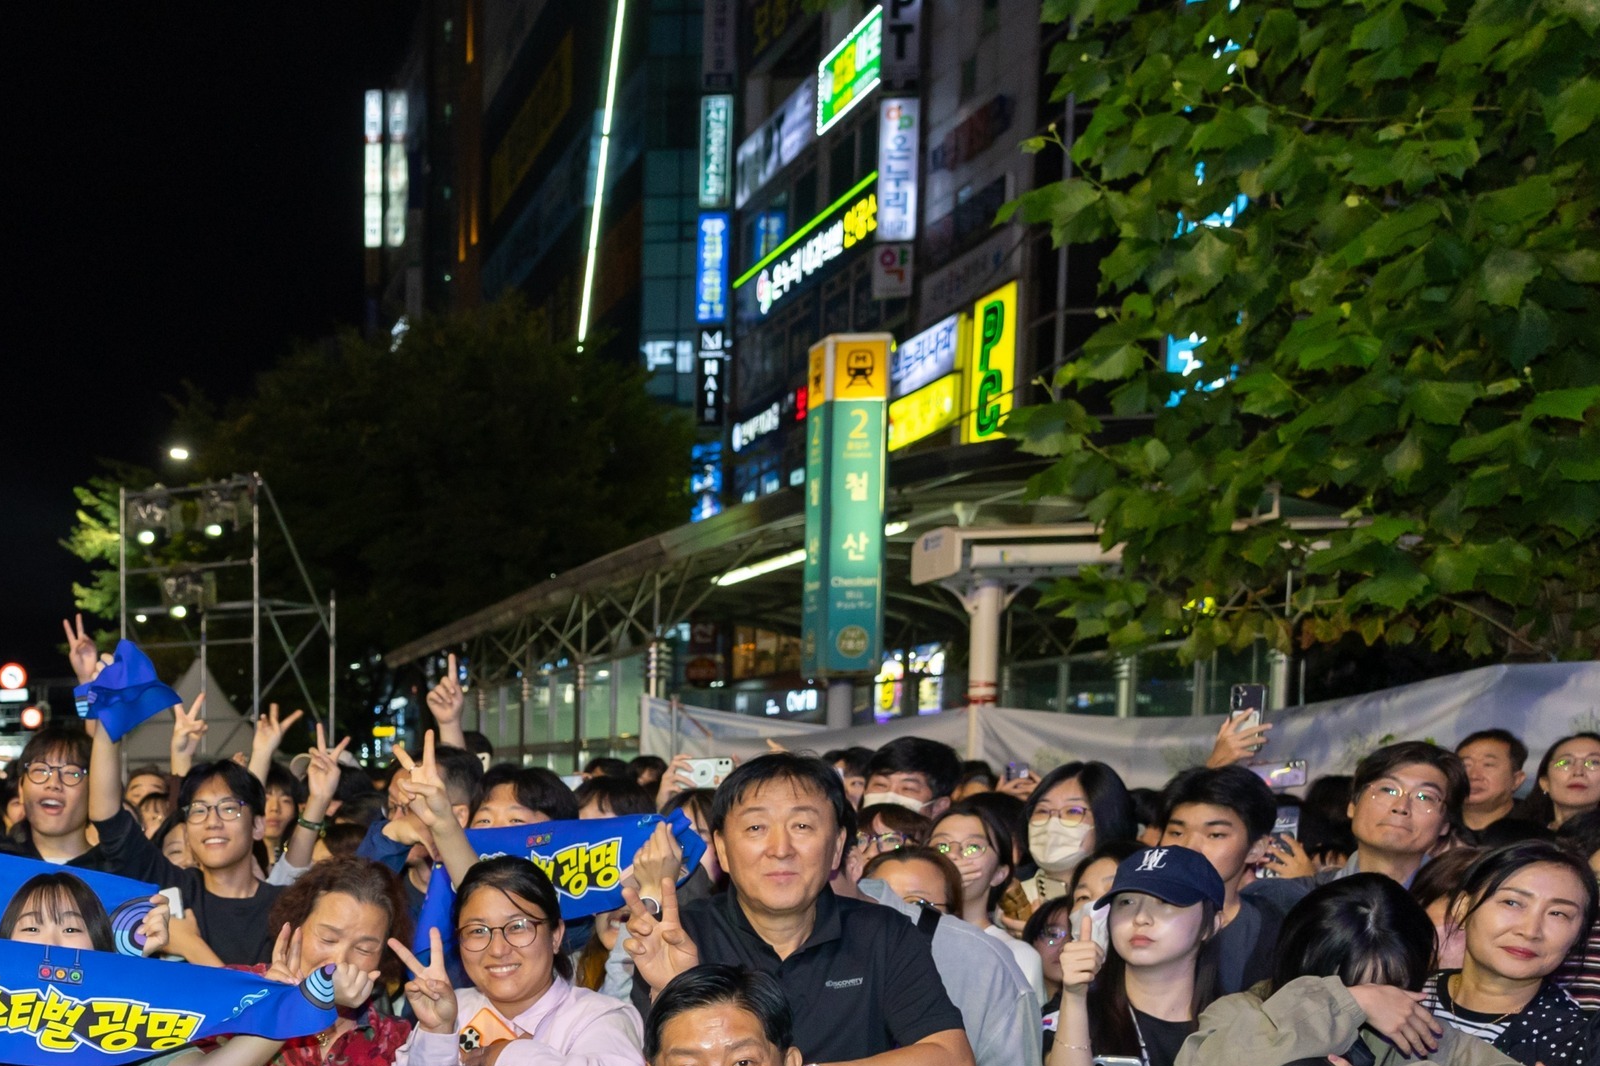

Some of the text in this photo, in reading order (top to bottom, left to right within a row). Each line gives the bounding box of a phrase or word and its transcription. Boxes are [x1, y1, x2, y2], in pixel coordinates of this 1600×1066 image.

[976, 300, 1005, 437] PC
[849, 409, 868, 439] 2
[843, 472, 869, 561] 철산
[555, 840, 619, 896] 광명
[88, 1001, 200, 1051] 광명
